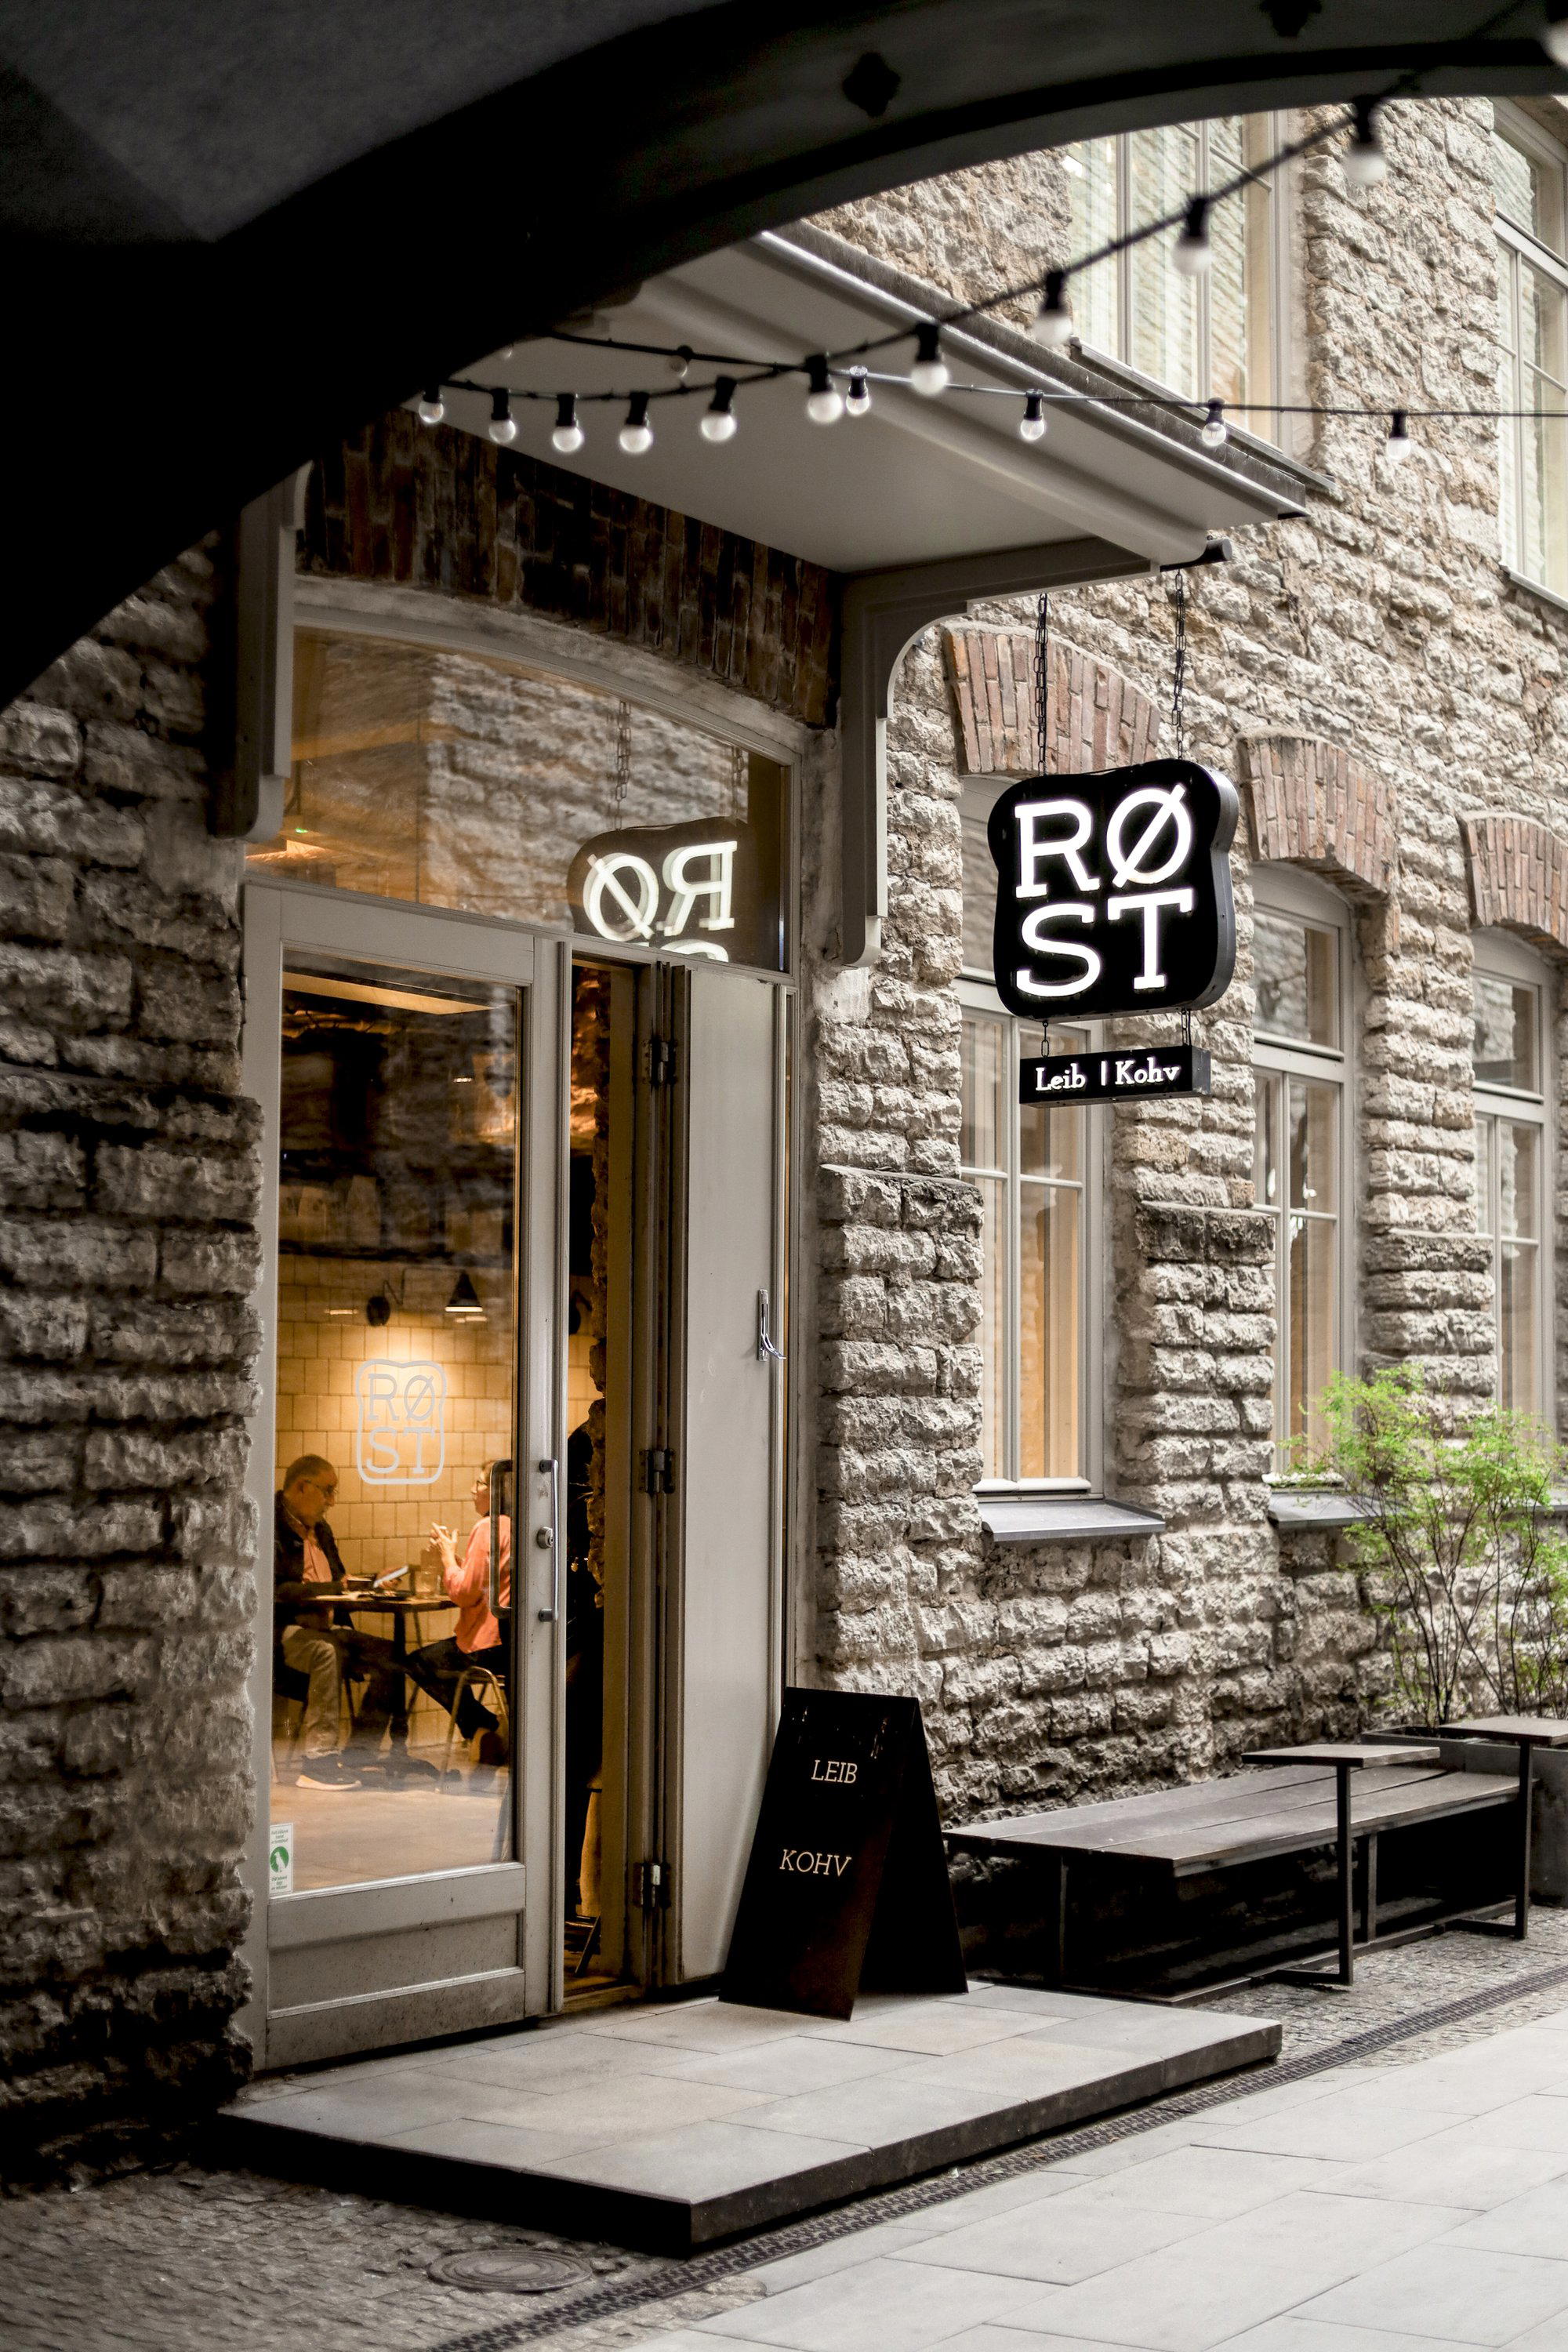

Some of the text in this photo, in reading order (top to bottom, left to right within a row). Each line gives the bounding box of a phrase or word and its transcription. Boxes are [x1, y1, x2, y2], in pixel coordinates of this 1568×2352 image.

[1014, 784, 1192, 898] RØ
[1016, 888, 1193, 997] ST
[1035, 1062, 1087, 1091] Leib
[1115, 1057, 1181, 1086] Kohv
[366, 1426, 436, 1474] ST
[811, 1759, 858, 1784] LEIB
[779, 1849, 852, 1877] KOHV
